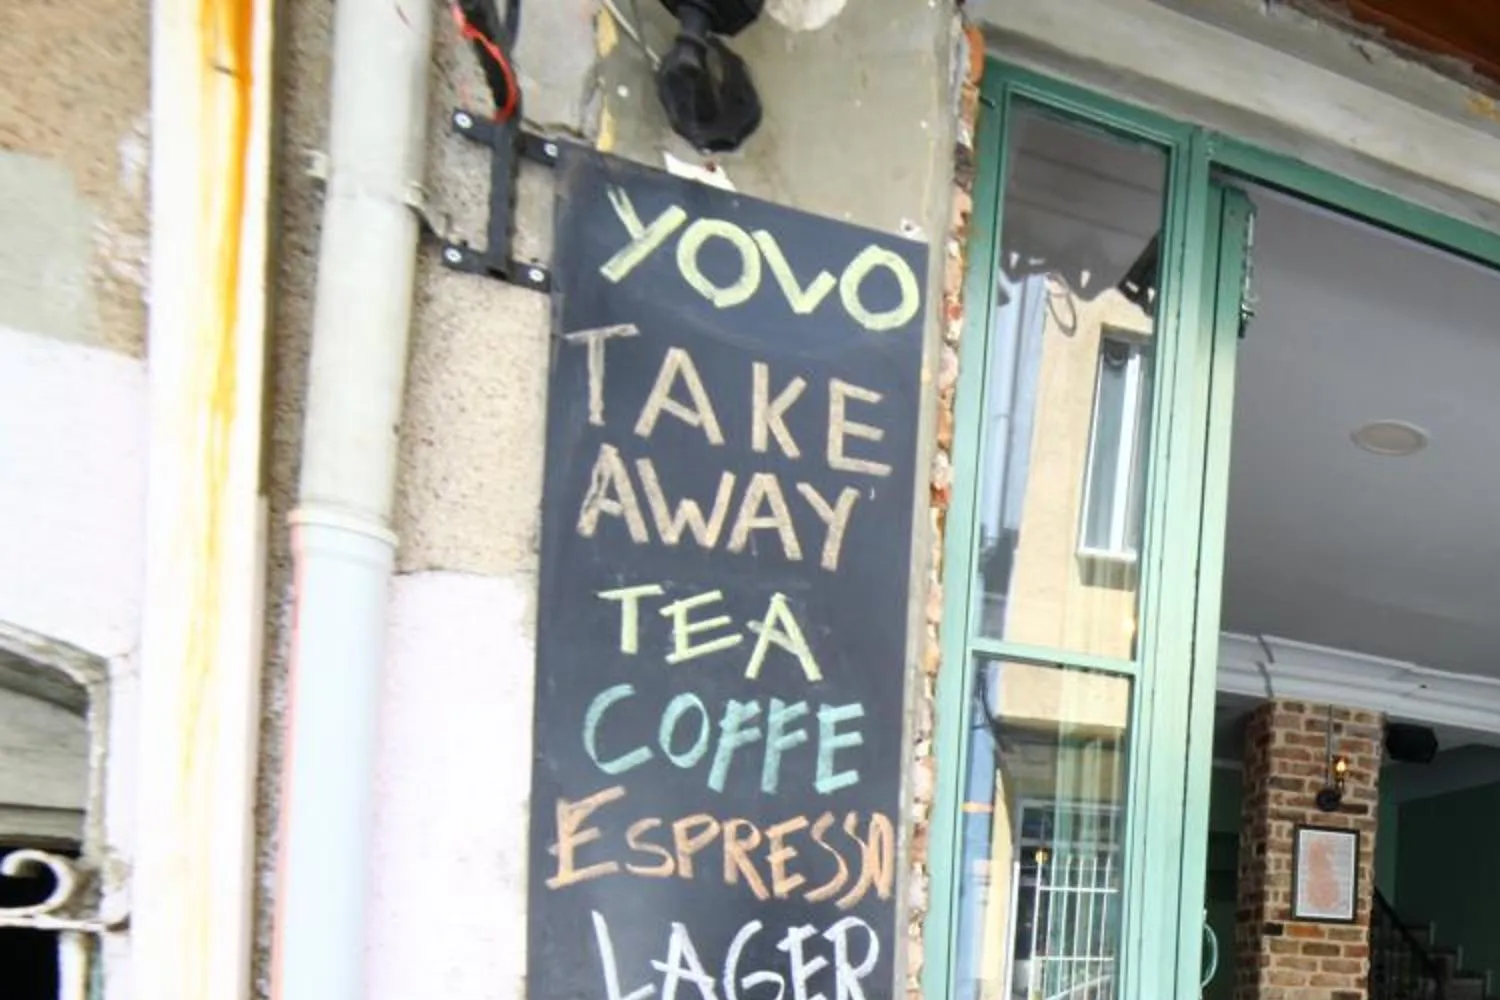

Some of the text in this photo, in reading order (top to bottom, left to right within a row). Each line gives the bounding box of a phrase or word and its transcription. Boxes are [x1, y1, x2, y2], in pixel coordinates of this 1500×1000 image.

[600, 184, 920, 331] YOVO
[563, 323, 892, 476] TAKE
[576, 443, 860, 571] AWAY
[597, 584, 824, 681] TEA
[583, 683, 865, 794] COFFE
